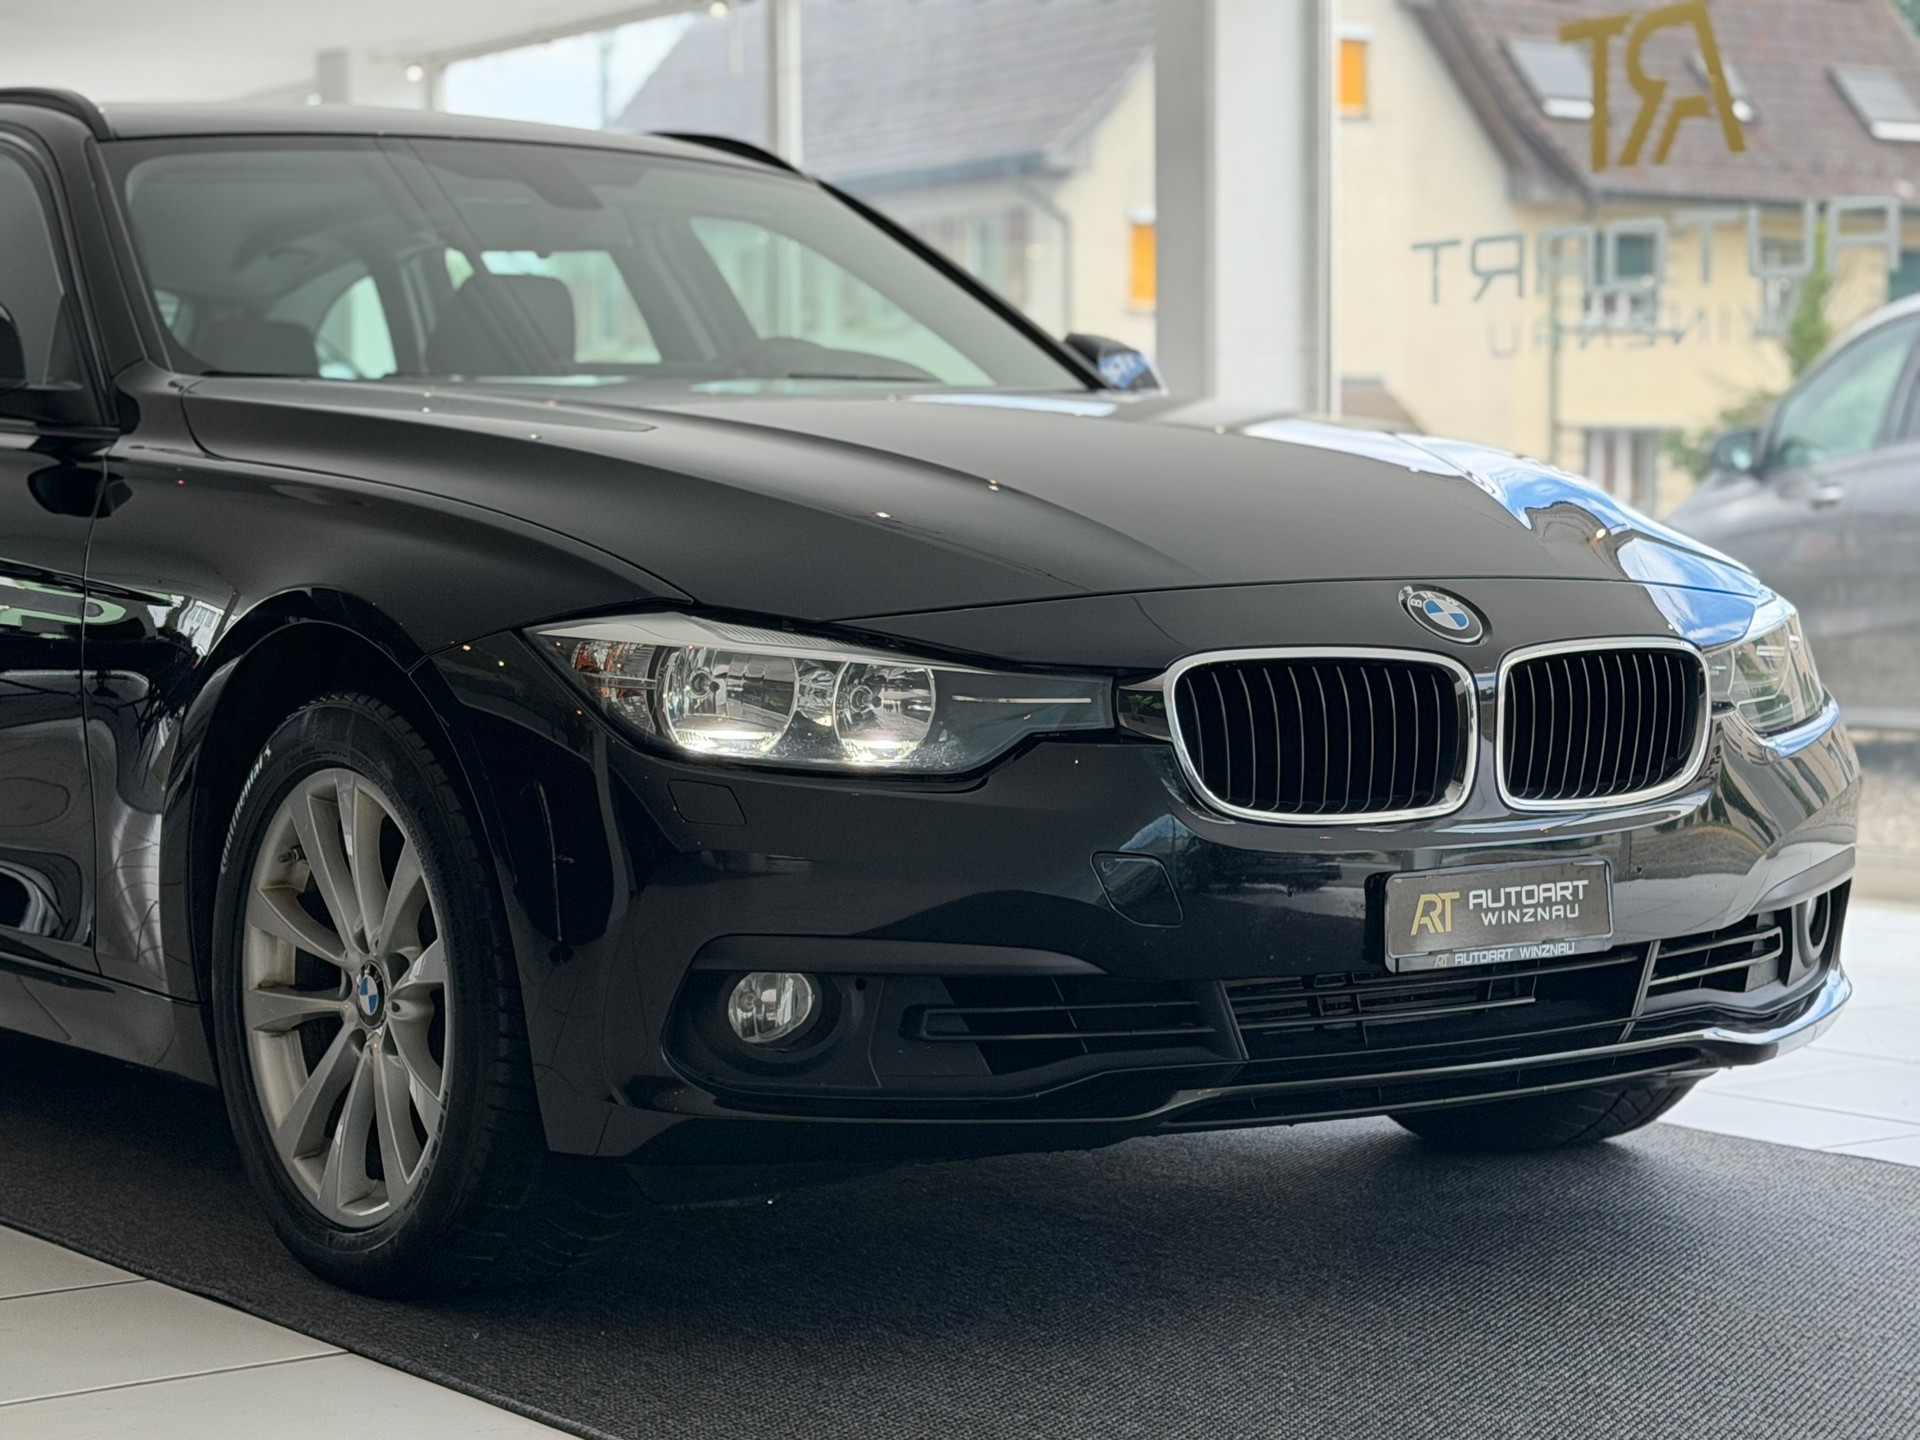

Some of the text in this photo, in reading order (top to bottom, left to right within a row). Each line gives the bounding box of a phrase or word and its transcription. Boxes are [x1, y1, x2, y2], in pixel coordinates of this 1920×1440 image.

[1468, 880, 1589, 910] AUTOART
[1481, 903, 1579, 926] WINZNAU
[1454, 948, 1513, 966] AUTOART
[1519, 941, 1575, 957] WINZNAU
